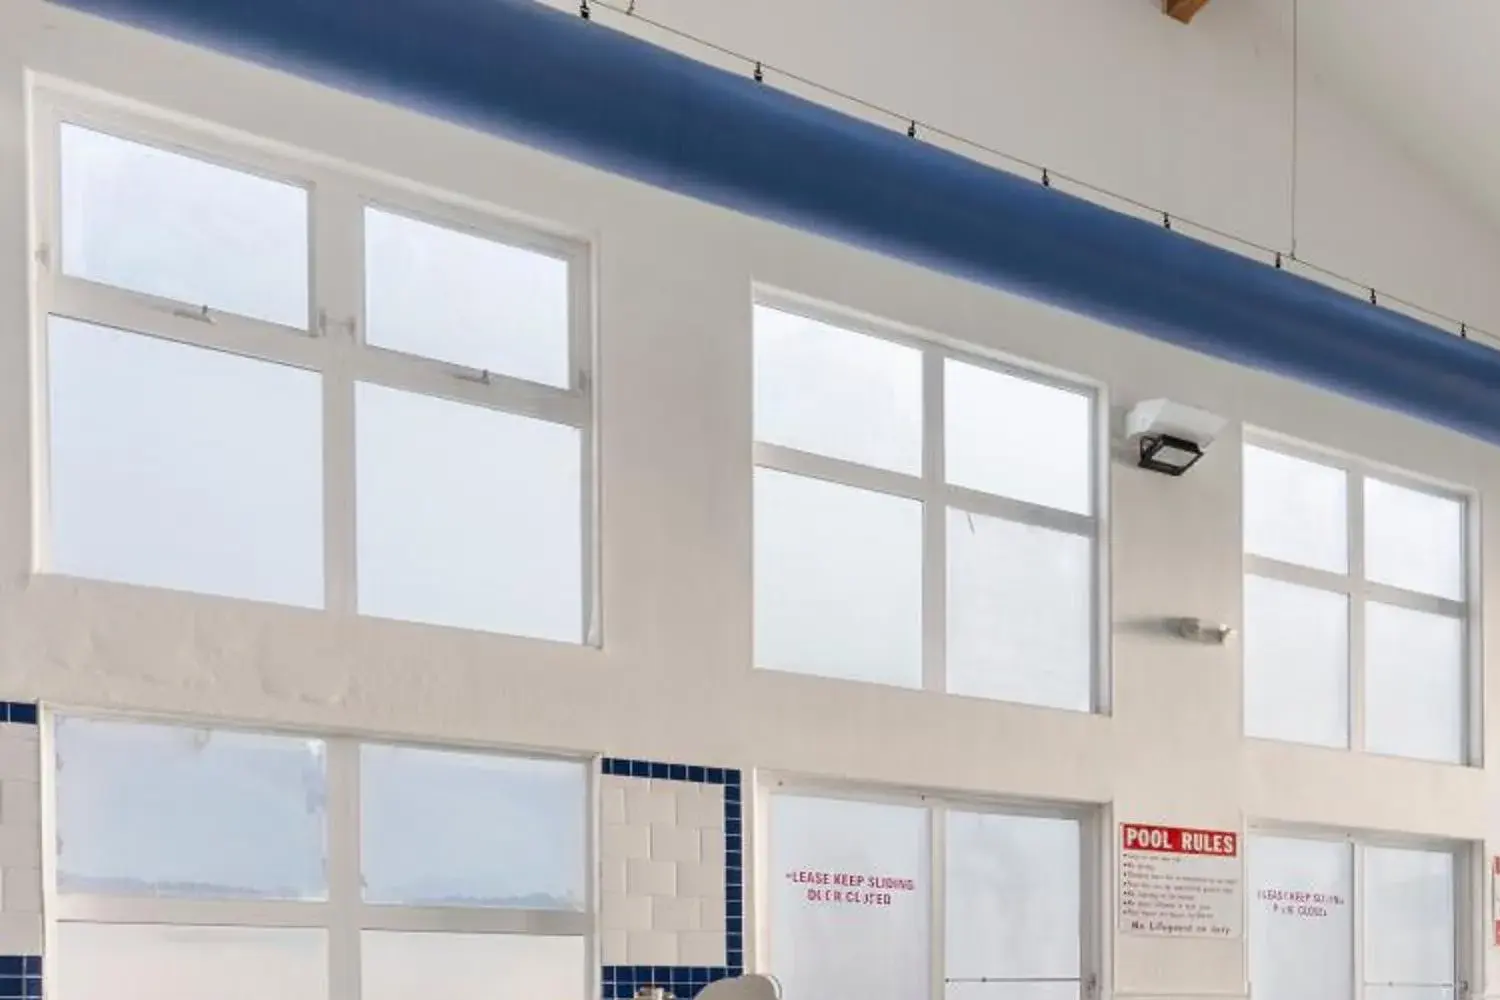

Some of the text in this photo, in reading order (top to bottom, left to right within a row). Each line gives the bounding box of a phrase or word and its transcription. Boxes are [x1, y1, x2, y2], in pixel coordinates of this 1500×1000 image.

[1126, 828, 1234, 853] POOL RULES
[833, 874, 865, 887] KEEP
